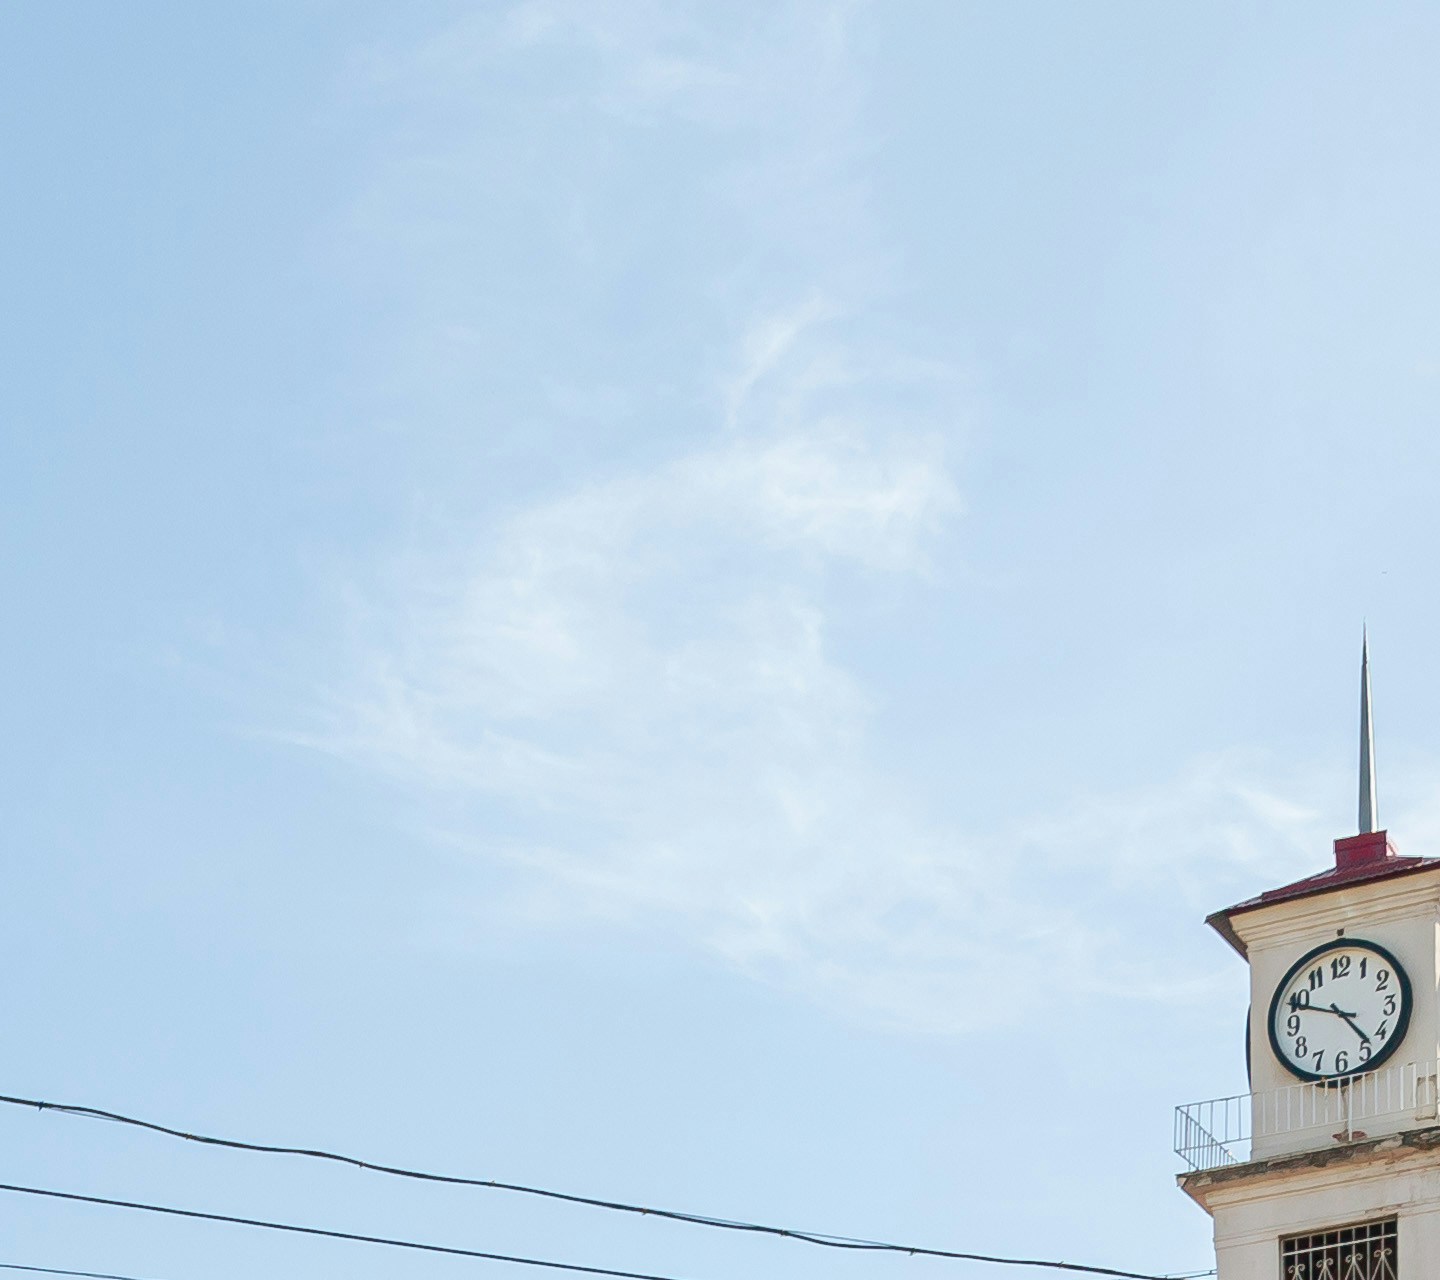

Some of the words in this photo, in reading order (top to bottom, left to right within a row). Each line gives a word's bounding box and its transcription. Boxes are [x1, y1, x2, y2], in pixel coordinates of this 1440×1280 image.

[1308, 966, 1324, 991] 11
[1330, 955, 1350, 980] 12
[1360, 957, 1368, 980] 1
[1376, 970, 1390, 992] 2
[1289, 988, 1310, 1013] 10
[1383, 994, 1396, 1016] 3
[1287, 1015, 1300, 1036] 9
[1374, 1020, 1388, 1040] 4
[1295, 1036, 1308, 1058] 8
[1359, 1040, 1372, 1062] 5
[1312, 1049, 1325, 1072] 7
[1336, 1050, 1348, 1073] 6
